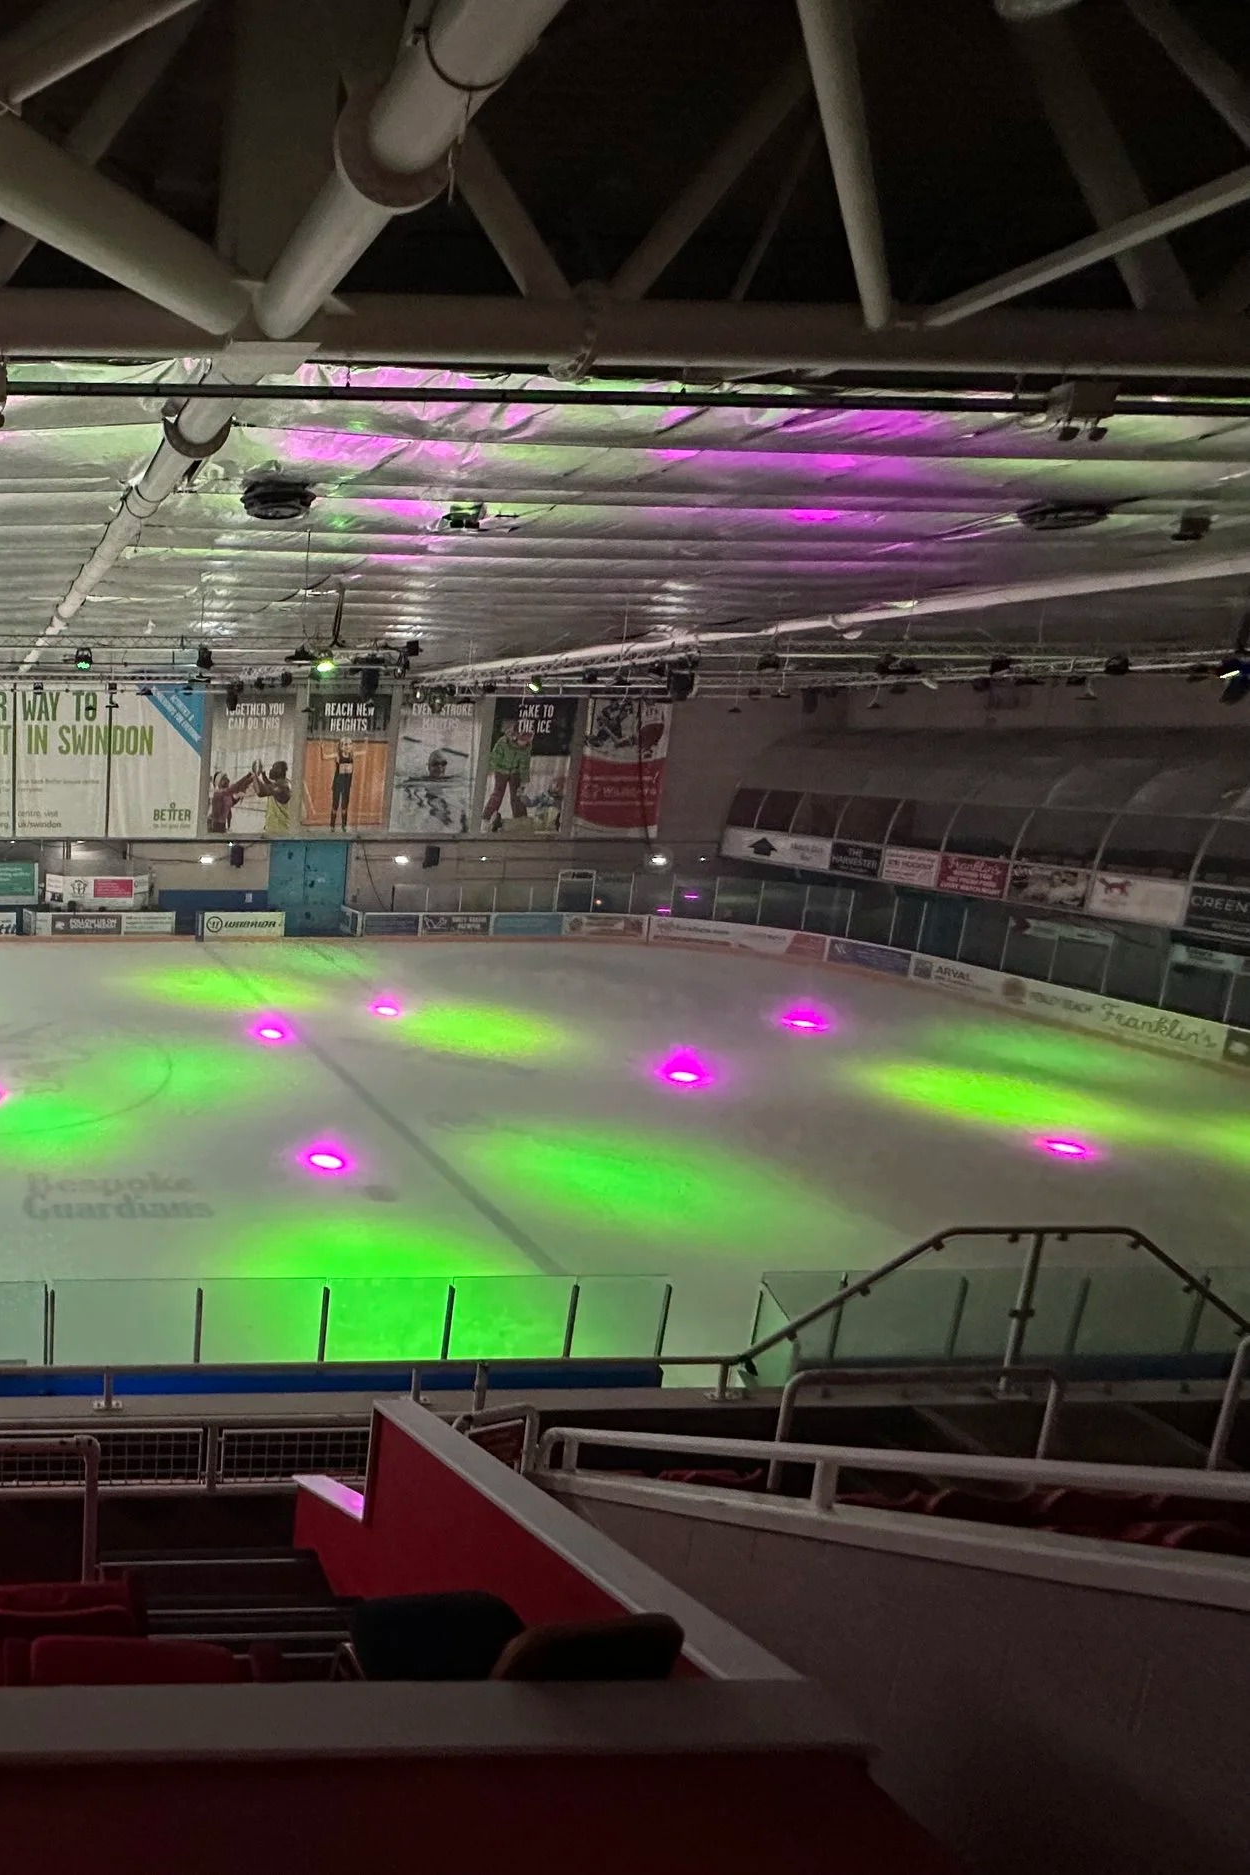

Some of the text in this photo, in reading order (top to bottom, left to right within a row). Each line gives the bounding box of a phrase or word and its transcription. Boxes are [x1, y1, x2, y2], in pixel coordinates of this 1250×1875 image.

[21, 691, 60, 721] WAY
[72, 691, 98, 721] TO
[269, 702, 285, 715] YOU
[325, 703, 375, 717] REACH NEW
[543, 704, 555, 718] TO
[228, 717, 280, 730] CAN DO THIS
[330, 718, 368, 732] HEIGHTS
[518, 719, 552, 734] THE ICE
[27, 724, 48, 755] IN
[58, 724, 154, 755] SWINDON
[153, 809, 191, 821] BETTER
[1191, 895, 1249, 913] GREEN
[23, 1193, 215, 1219] Guardians
